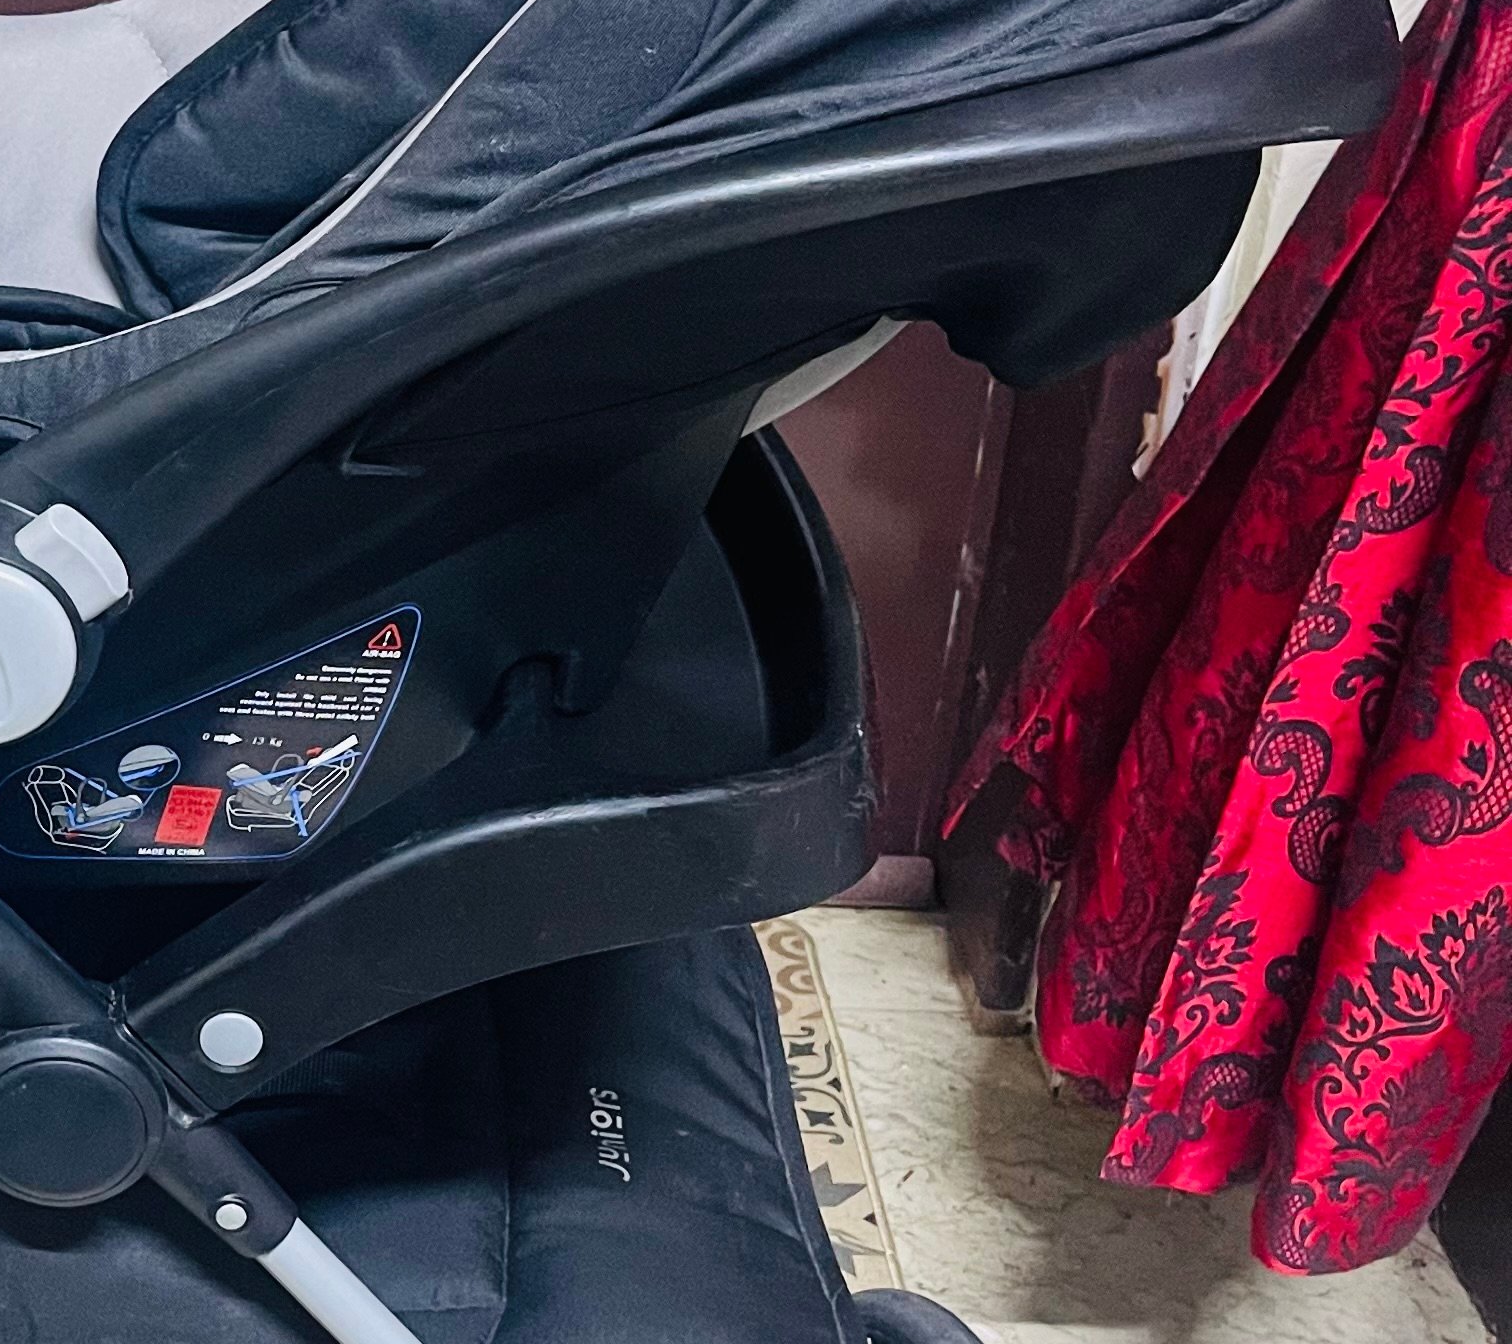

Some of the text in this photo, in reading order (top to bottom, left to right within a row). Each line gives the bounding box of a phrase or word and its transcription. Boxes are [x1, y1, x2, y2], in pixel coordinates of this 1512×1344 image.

[138, 847, 206, 856] MADE IN CHINA
